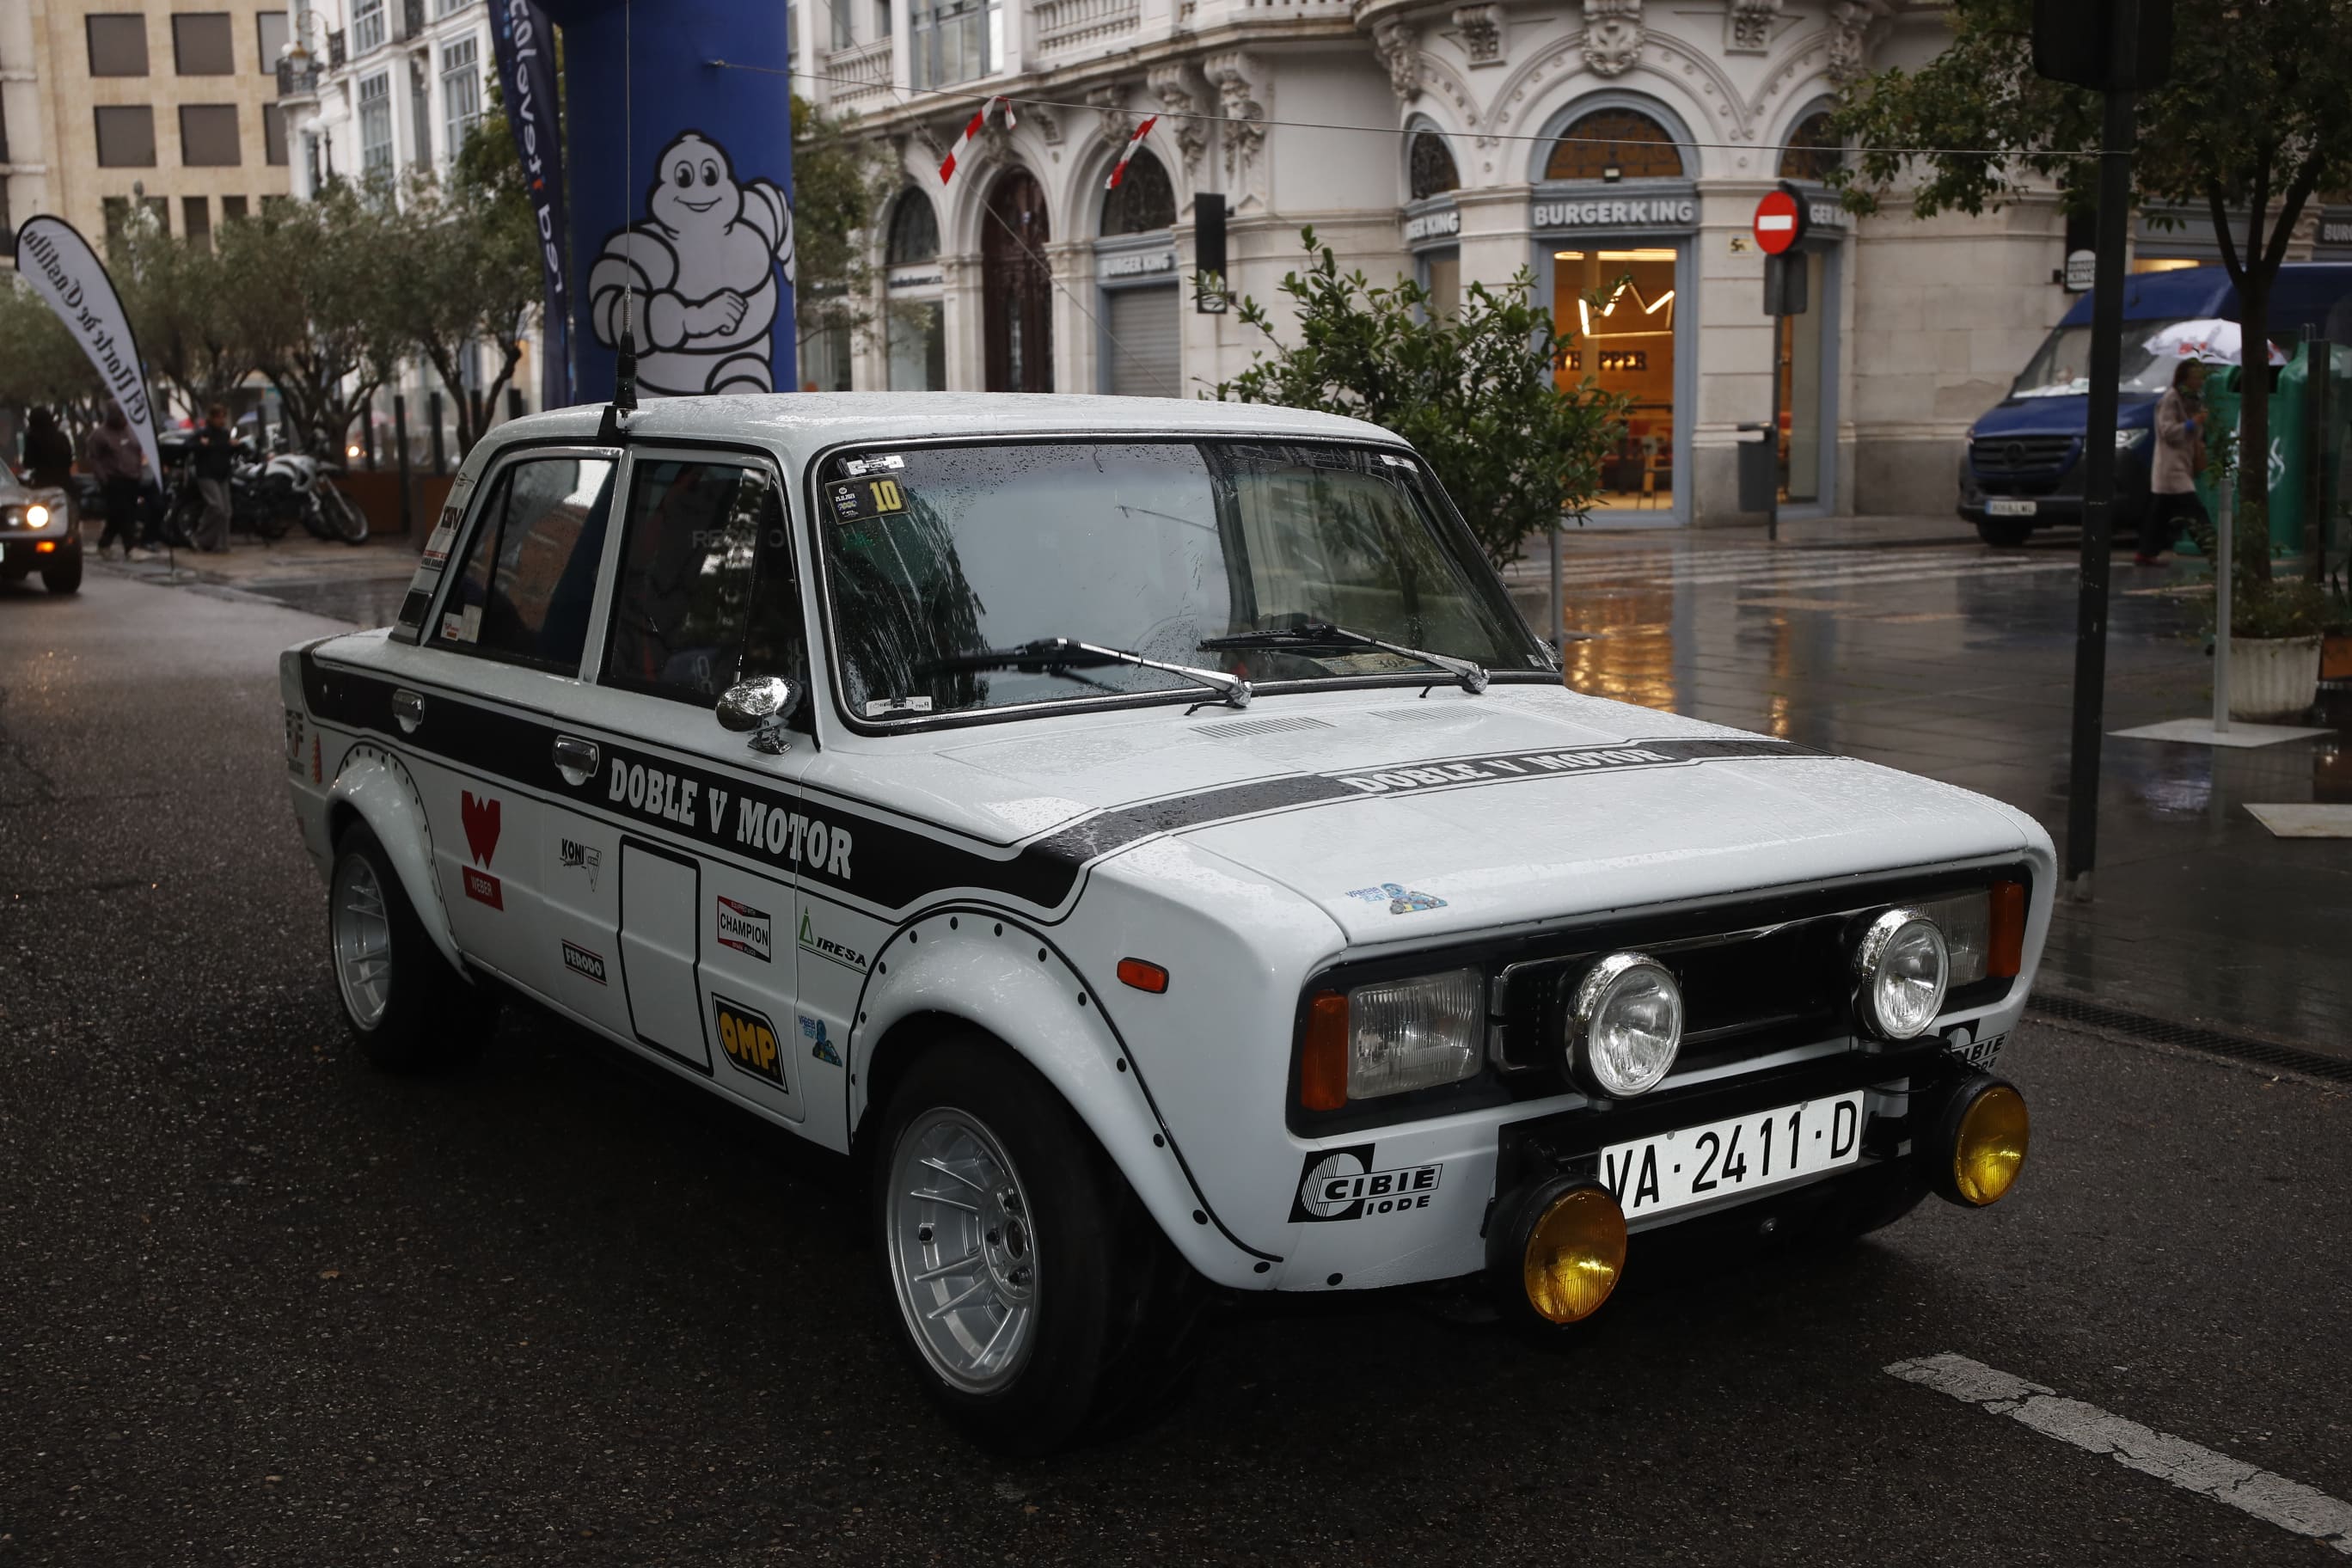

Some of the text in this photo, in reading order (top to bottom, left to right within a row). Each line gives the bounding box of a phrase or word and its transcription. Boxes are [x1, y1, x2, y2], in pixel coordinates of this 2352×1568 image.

[1426, 211, 1460, 233] KING
[1534, 199, 1694, 226] BURGER KING
[869, 480, 903, 512] 10
[692, 529, 785, 548] RECAO
[1337, 749, 1675, 793] DOBLE V MOTOR
[609, 757, 853, 880] DOBLE V MOTOR
[561, 837, 585, 863] KONI
[720, 912, 769, 946] CHAMPION
[565, 946, 602, 977] FERODO
[816, 937, 867, 967] IRESA
[720, 1011, 776, 1069] OMP
[1366, 1194, 1431, 1216] IODE
